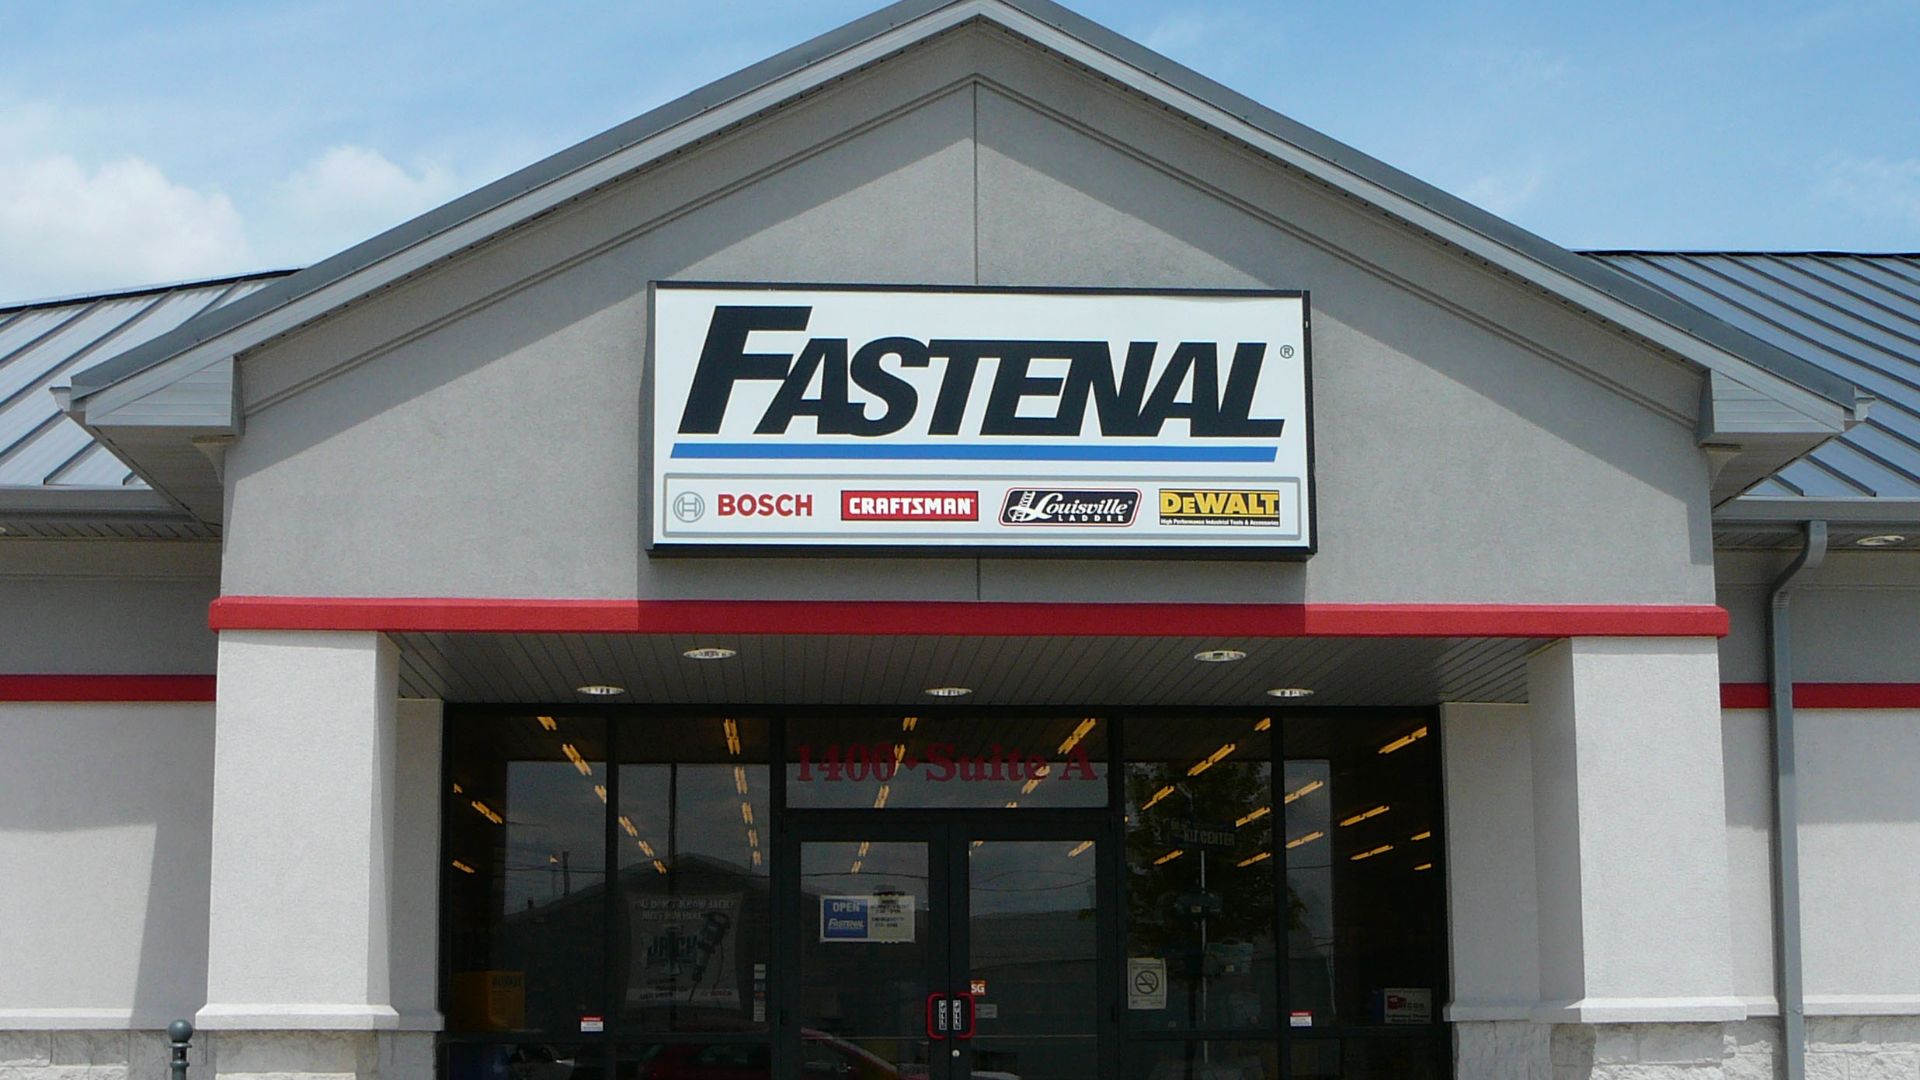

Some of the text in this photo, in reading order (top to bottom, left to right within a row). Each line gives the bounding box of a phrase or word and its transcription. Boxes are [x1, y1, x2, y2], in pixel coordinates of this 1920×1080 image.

[677, 305, 1286, 438] FASTENAL
[717, 494, 813, 517] BOSCH
[849, 497, 972, 516] CRAFTSMAN
[1008, 492, 1128, 521] Louisville
[796, 743, 1099, 782] 1400 Suite A
[832, 902, 861, 913] OPEN
